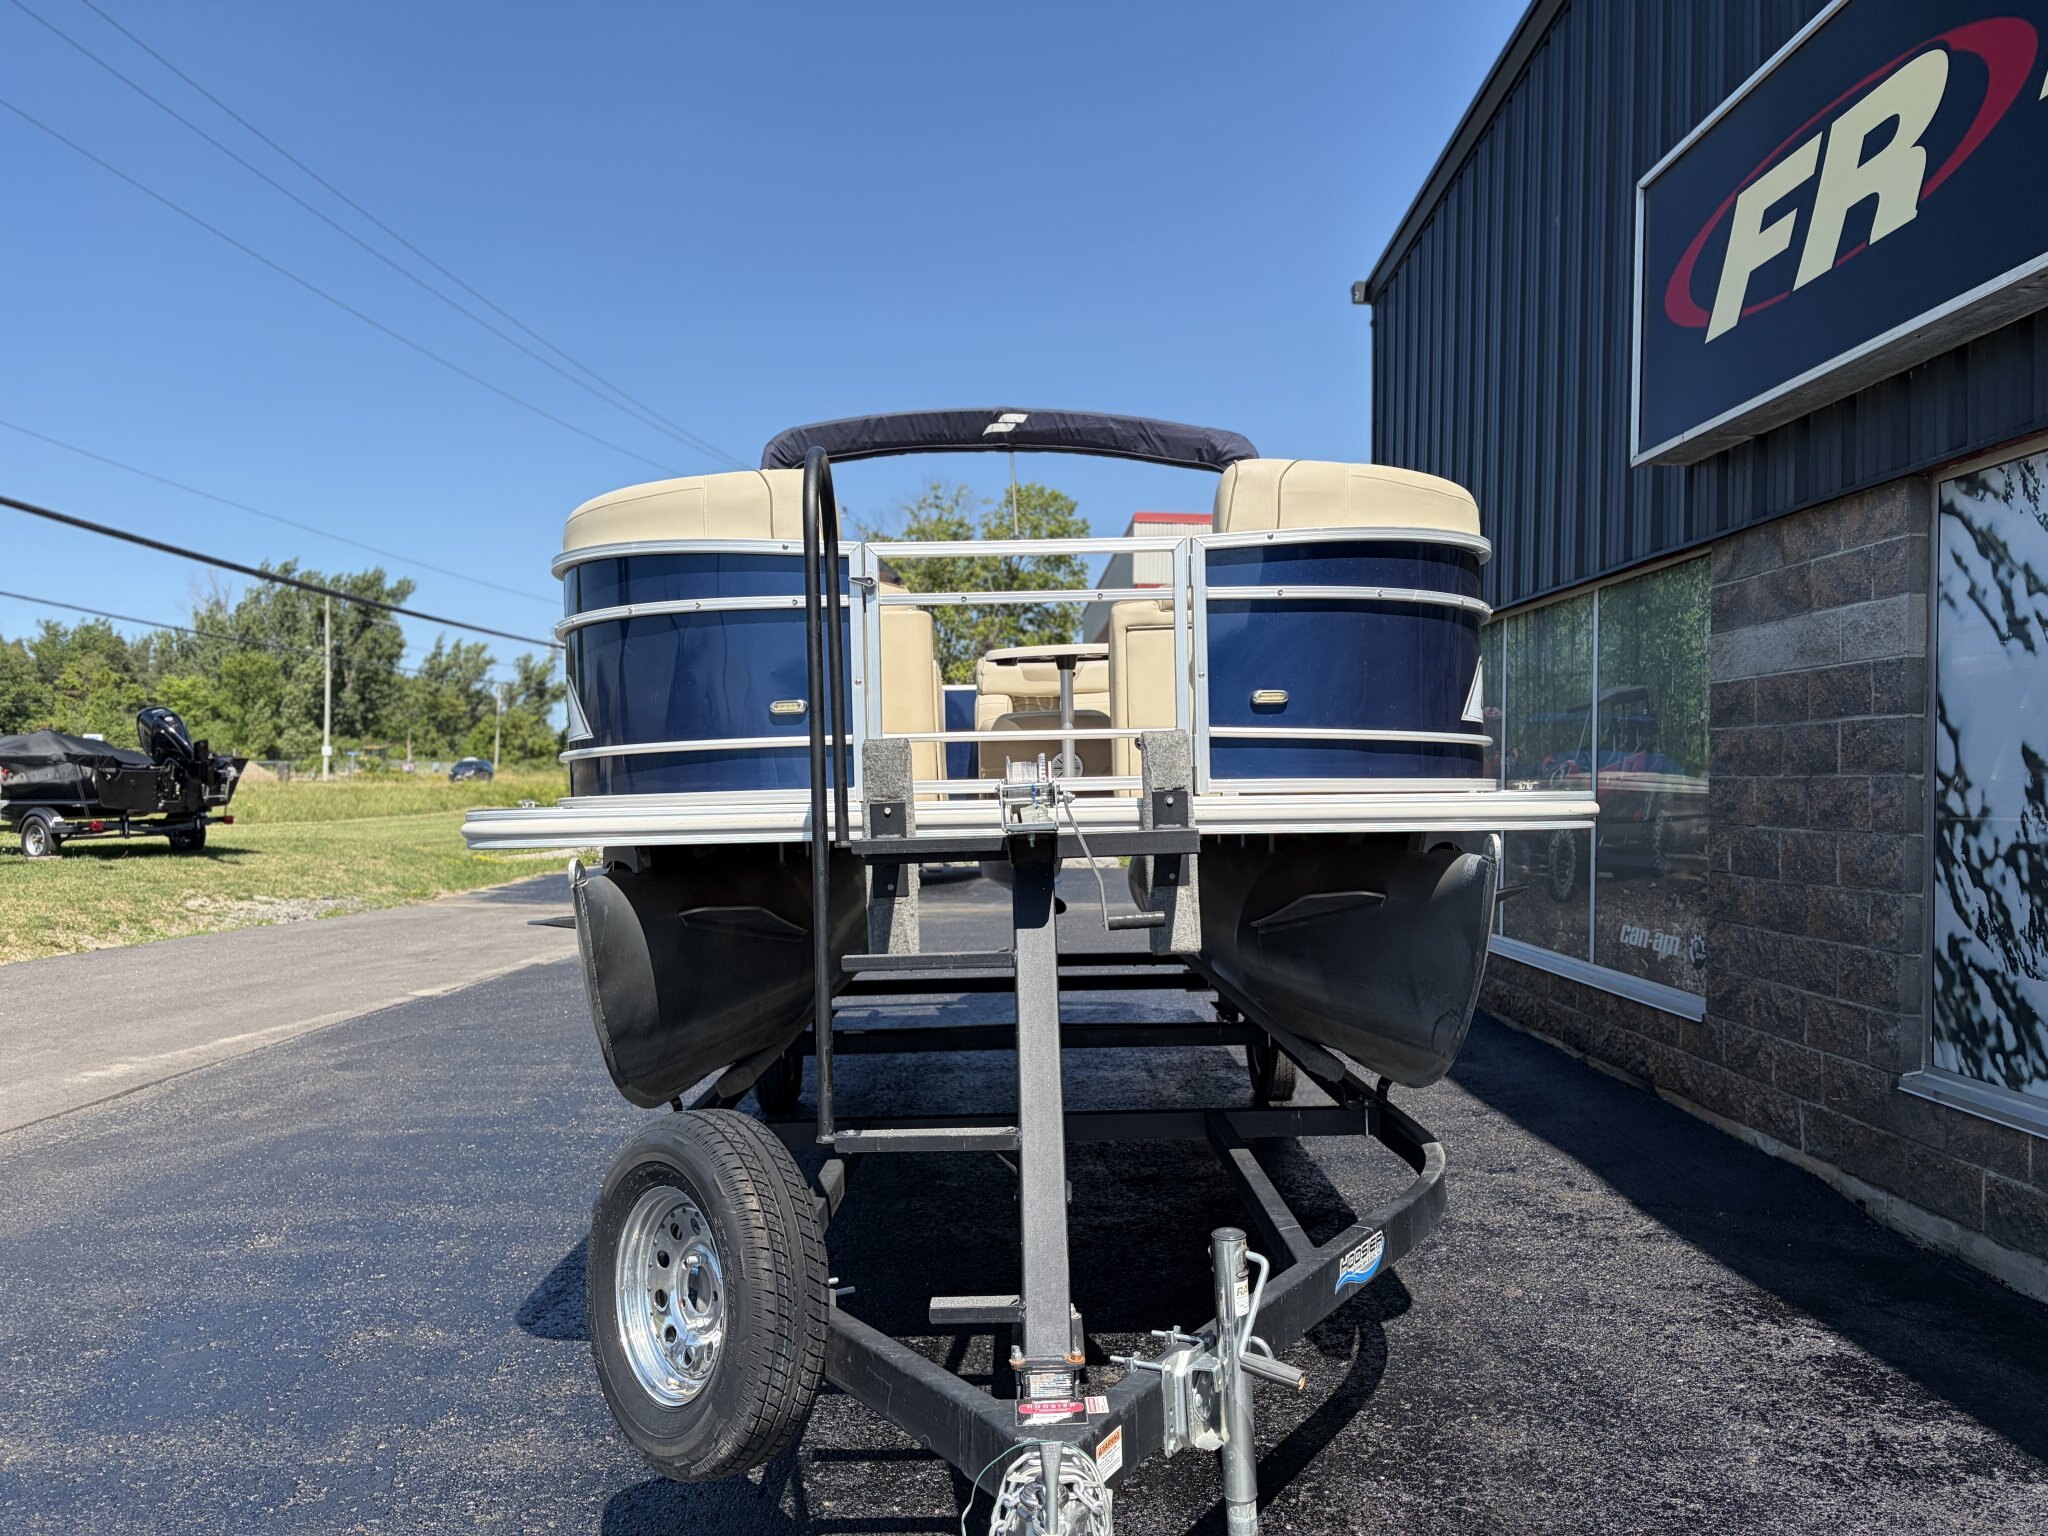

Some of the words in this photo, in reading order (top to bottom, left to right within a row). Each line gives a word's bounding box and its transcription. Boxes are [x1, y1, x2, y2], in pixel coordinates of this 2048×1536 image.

[1705, 49, 1949, 344] FR
[1620, 924, 1681, 957] can-am
[1340, 1230, 1383, 1277] HOOSIER
[1026, 1402, 1076, 1410] HOOSIER
[1101, 1430, 1120, 1452] WARNING
